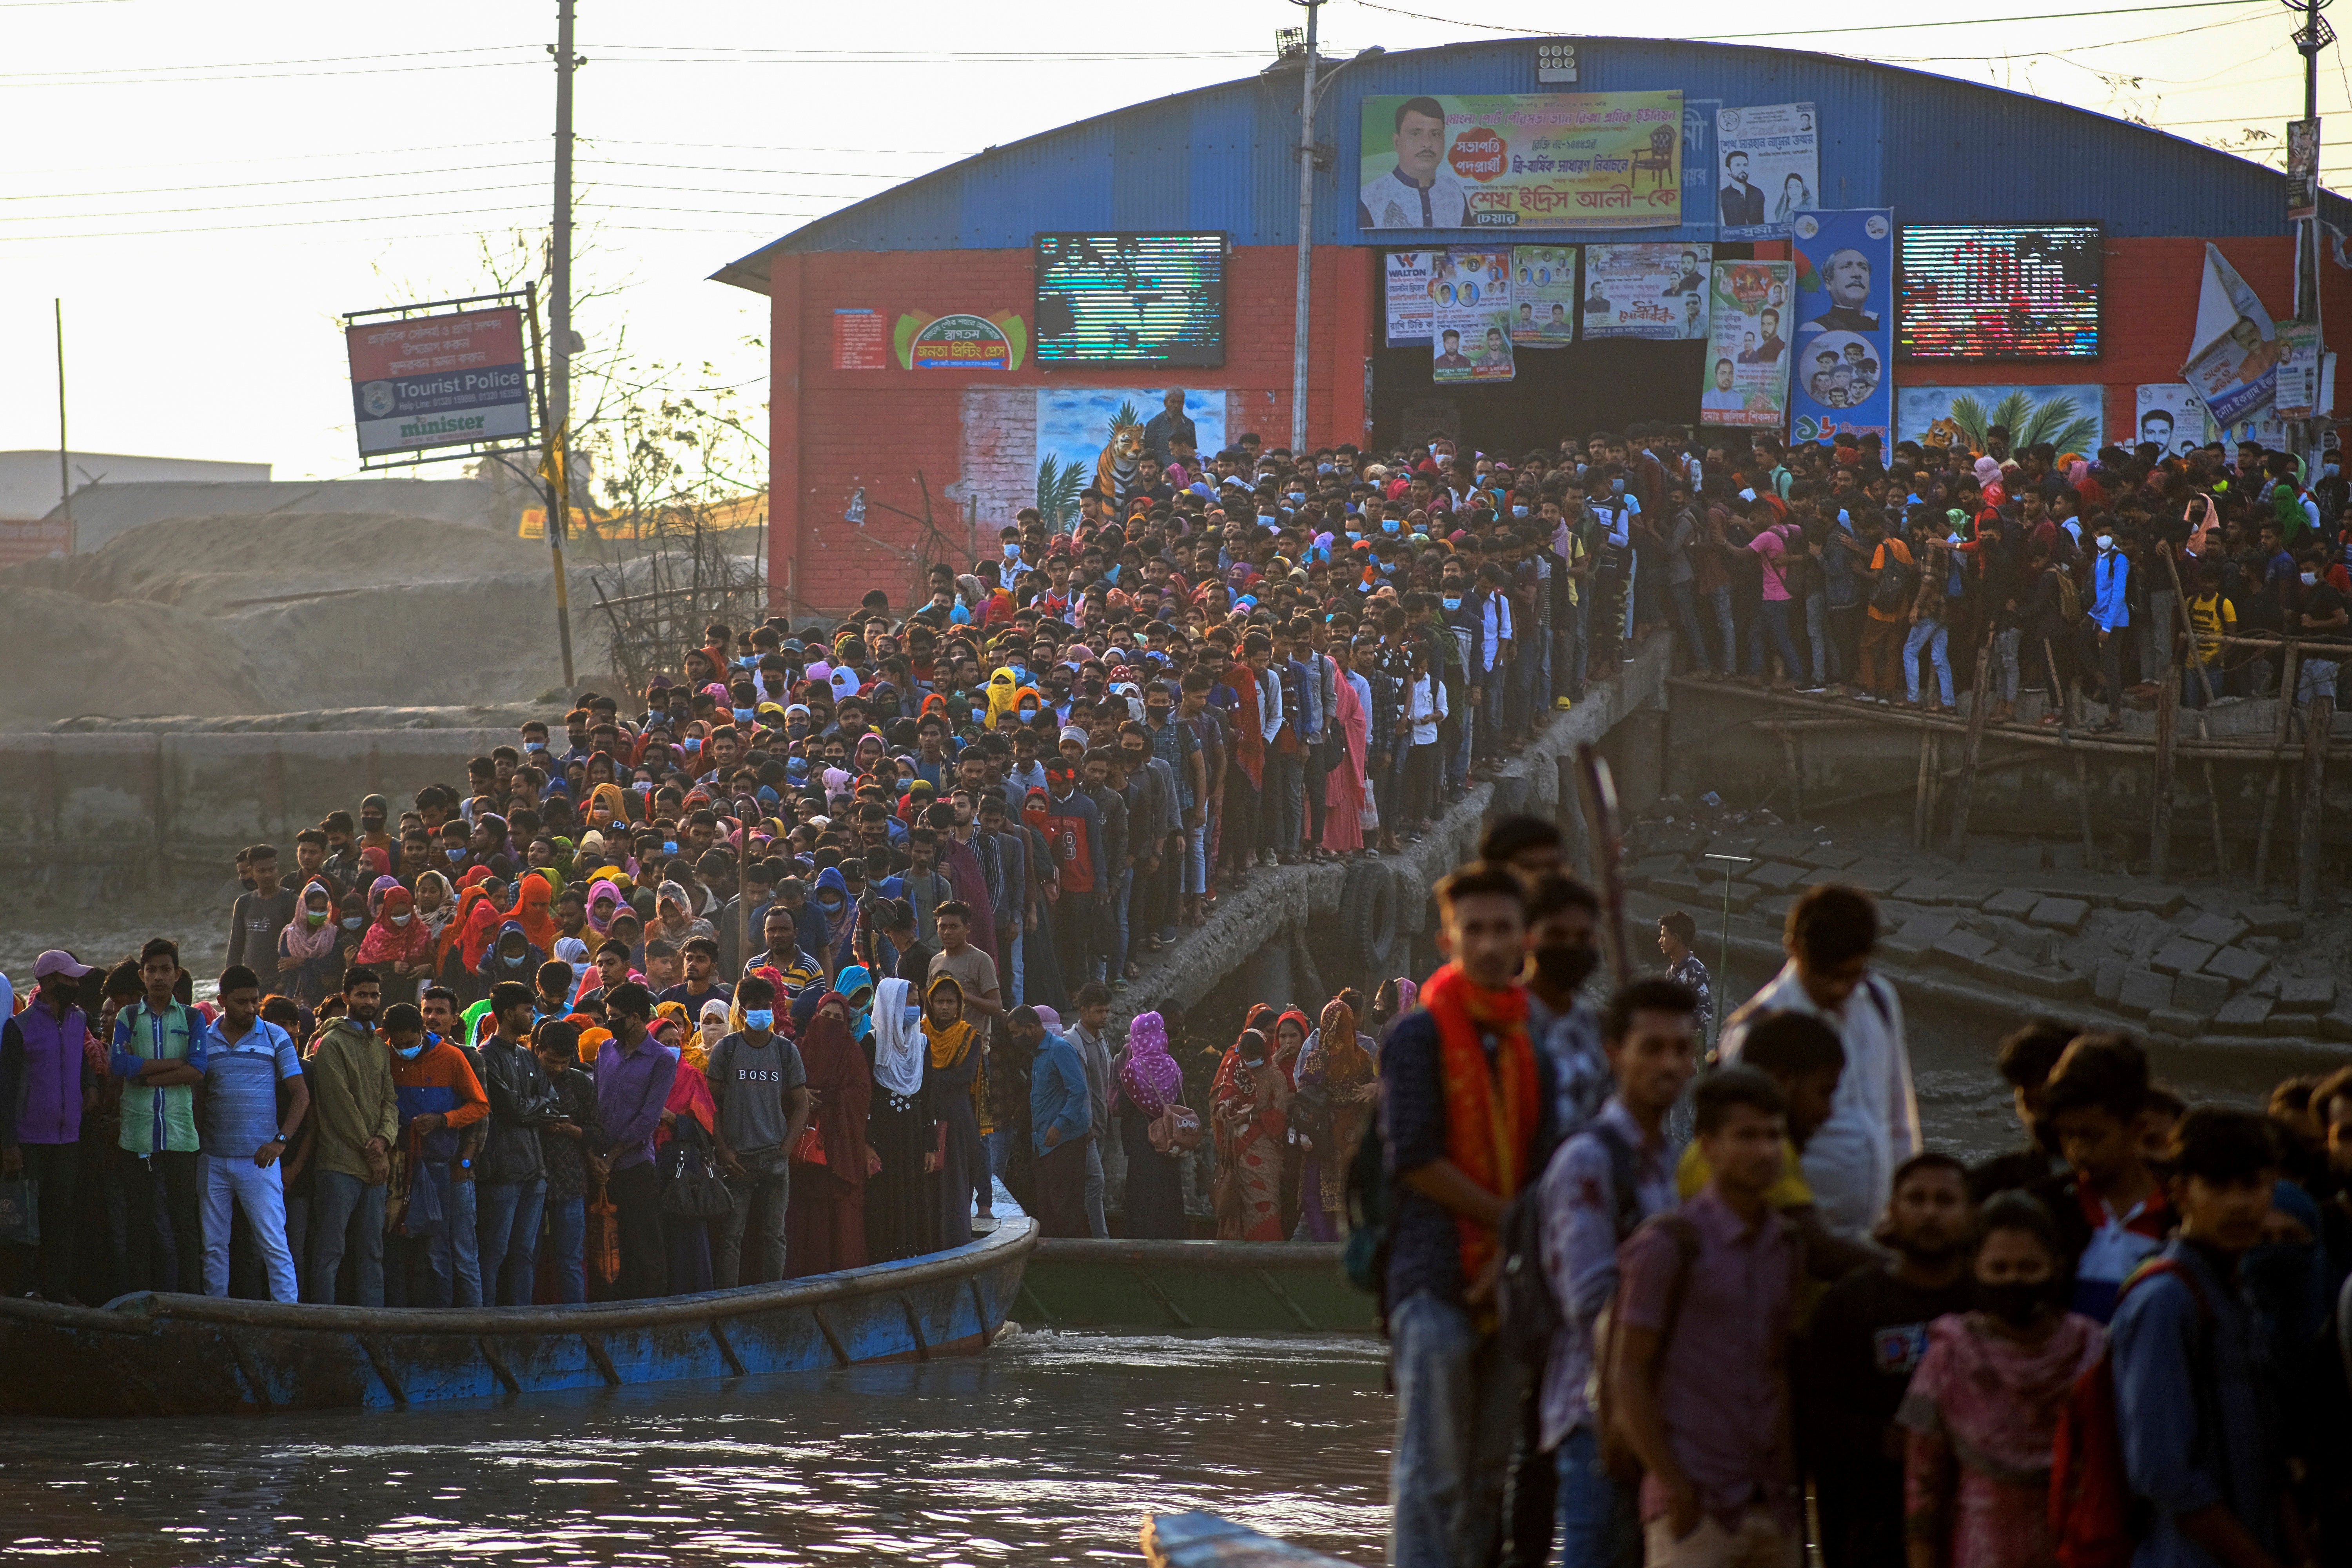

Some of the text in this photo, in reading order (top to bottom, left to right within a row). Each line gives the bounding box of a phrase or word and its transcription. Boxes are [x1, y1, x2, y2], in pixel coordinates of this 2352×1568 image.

[1445, 113, 1475, 125] মোংলা
[1479, 109, 1504, 125] পোর্ট
[1504, 111, 1547, 126] পৌরসভা
[1549, 113, 1572, 125] ভ্যান
[1603, 109, 1632, 123] শ্রমিক
[1635, 107, 1675, 122] ইউনিয়ন
[1456, 138, 1500, 154] সভাপতি
[1768, 136, 1790, 150] নাসের
[1456, 156, 1501, 172] পদপ্রার্থী
[1512, 154, 1628, 174] ত্রি-বার্ষিক সাধারণ নির্বাচনে
[1469, 192, 1513, 209] শেখ
[1519, 185, 1570, 212] ইদ্রিস
[1477, 213, 1516, 225] চেয়ার
[443, 327, 449, 336] ও
[924, 325, 941, 340] মোংলা
[942, 319, 956, 328] পৌর
[976, 322, 1001, 339] আপনাকে
[1408, 319, 1423, 329] টিভি
[944, 330, 980, 340] স্বাগতম
[917, 341, 1005, 358] জনতা প্রিন্টিং প্রেস
[397, 372, 520, 397] Tourist Police
[399, 401, 414, 411] Help
[416, 399, 431, 408] Line:
[1702, 412, 1720, 421] মোঃ
[1749, 410, 1779, 422] শিকদার
[400, 416, 485, 436] minister
[1795, 414, 1837, 441] ১৬
[1063, 831, 1076, 860] 8
[739, 1070, 778, 1081] BOSS
